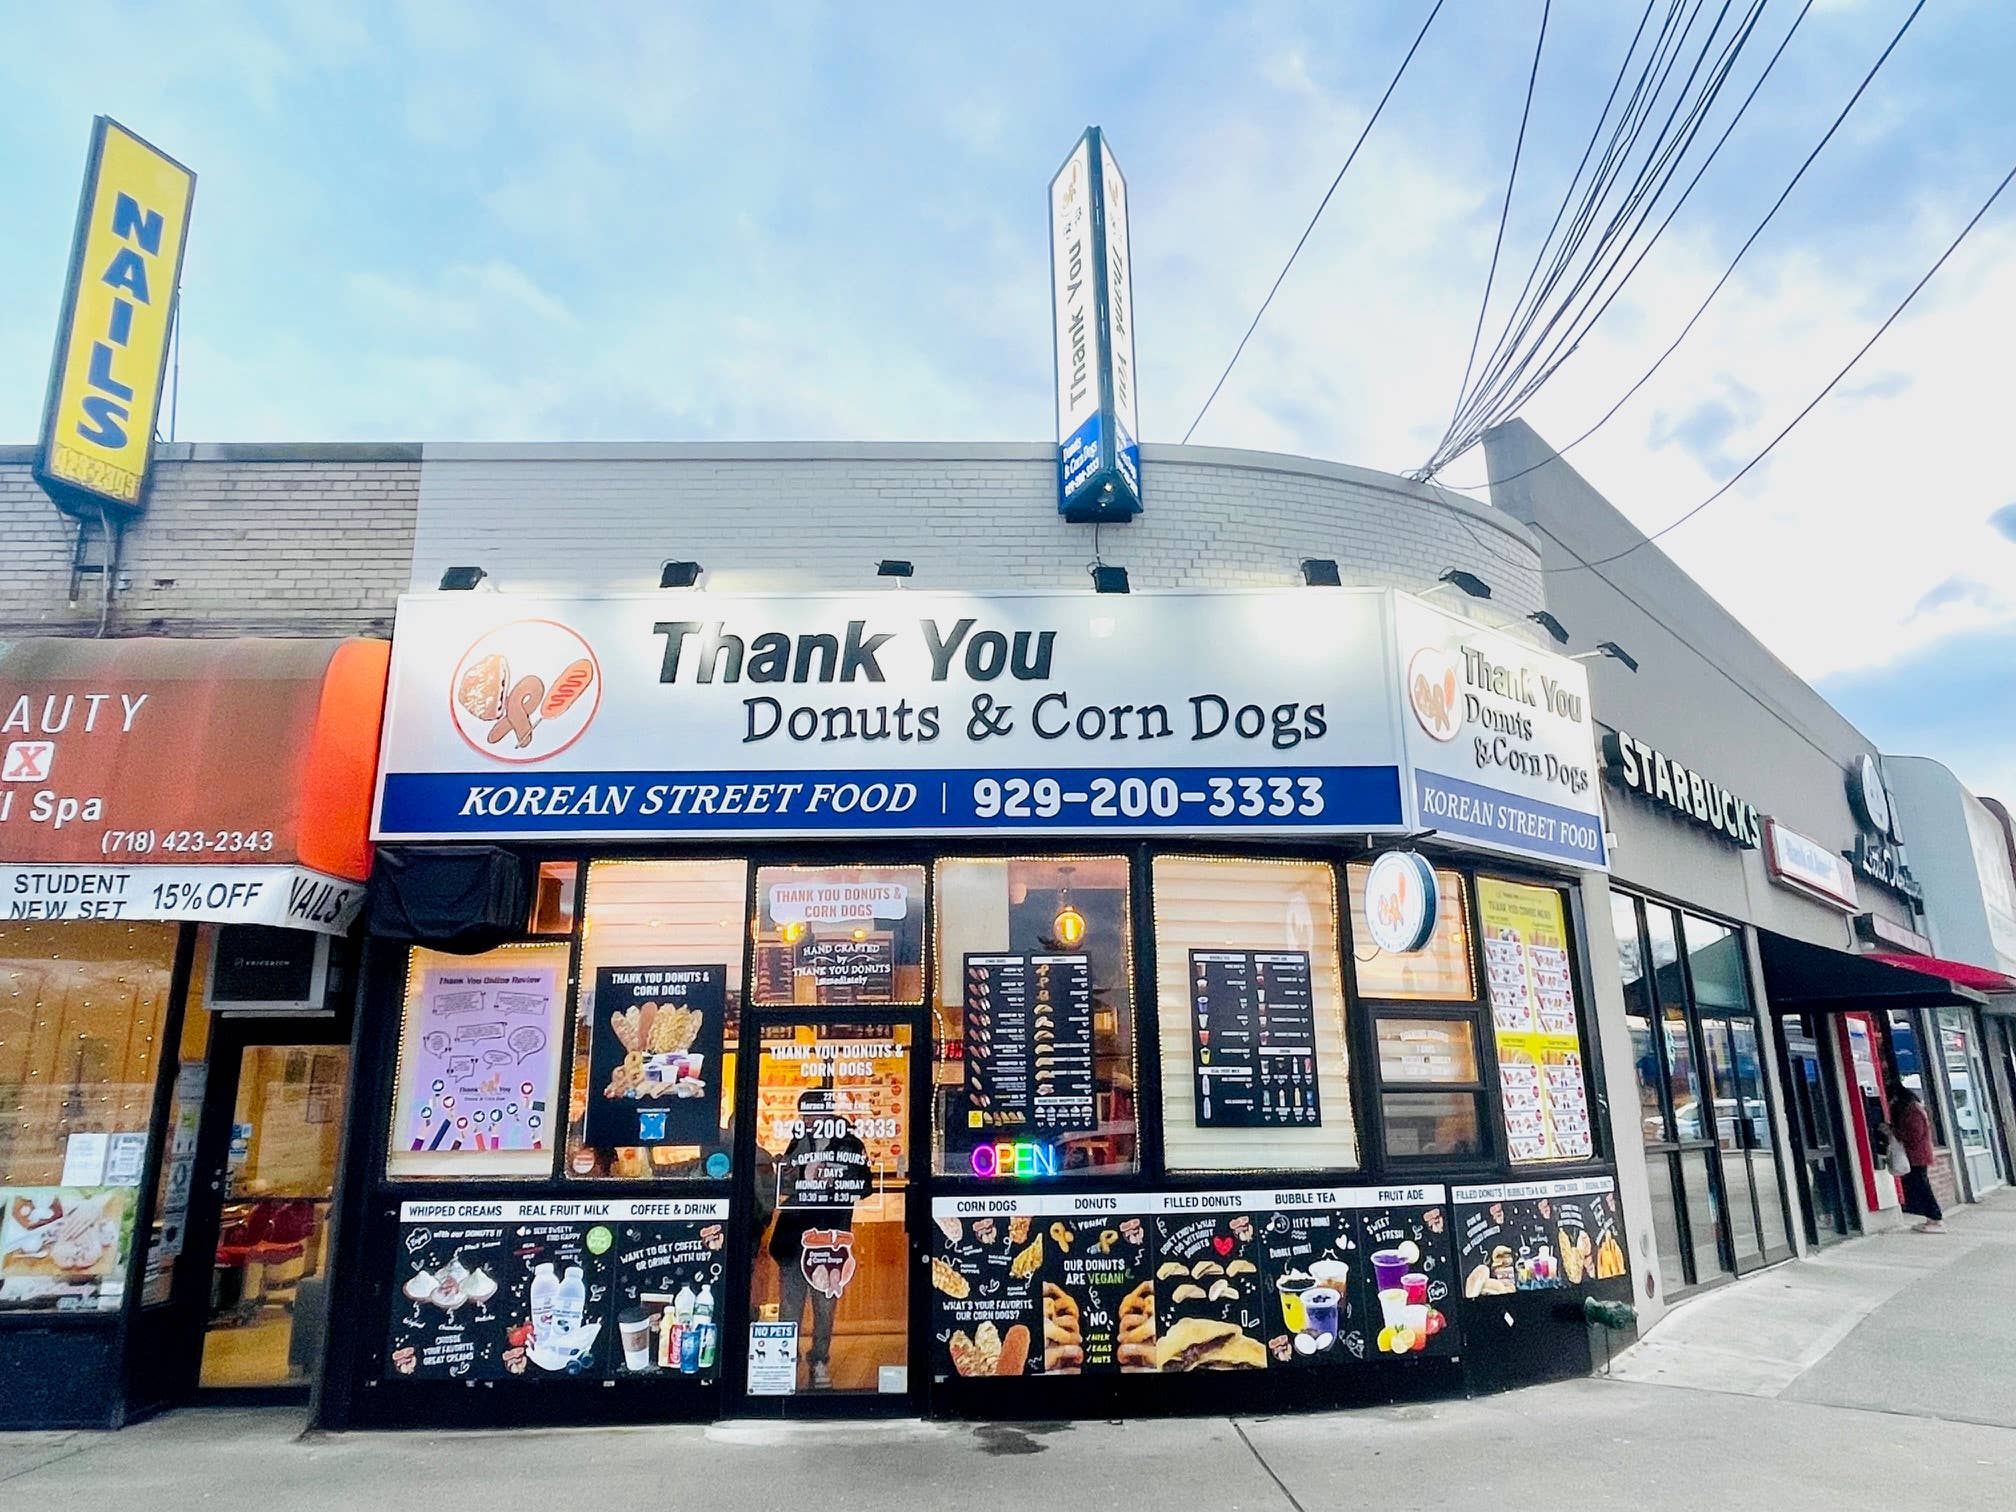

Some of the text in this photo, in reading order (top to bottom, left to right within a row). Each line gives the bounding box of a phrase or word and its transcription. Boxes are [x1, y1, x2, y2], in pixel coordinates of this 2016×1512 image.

[1067, 238, 1083, 304] You
[76, 191, 163, 448] NAILS
[1069, 305, 1087, 411] Thank
[653, 618, 1058, 685] Thank You
[1461, 645, 1583, 723] Thank You
[742, 691, 1328, 750] Donuts & Corn Dogs
[1465, 693, 1533, 741] Donuts
[1473, 735, 1589, 794] & Corn Dogs
[973, 776, 1325, 818] 929-200-3333
[1618, 730, 1761, 850] STARBUCKS
[458, 782, 918, 817] KOREAN STREET FOOD
[29, 788, 103, 830] Spa
[1422, 786, 1598, 851] KOREAN STREET FOOD
[101, 830, 274, 854] (718) 423-2343
[14, 873, 130, 894] STUDENT
[152, 882, 263, 911] 15% OFF
[775, 887, 901, 903] THANK YOU DONUTS &
[9, 900, 128, 920] NEW SET
[804, 904, 873, 918] CORN DOGS
[803, 944, 880, 956] HAND CRAFTED
[611, 971, 710, 984] THANK YOU DONUTS &
[793, 964, 891, 977] THANK YOU DONUTS
[633, 985, 686, 996] CORN DOGS
[770, 1044, 904, 1060] THANK YOU DONUTS &
[800, 1062, 873, 1077] CORN DOGS
[797, 1150, 867, 1166] OPENING HOURS
[971, 1143, 1057, 1177] OPEN
[824, 1168, 844, 1178] DAYS
[795, 1180, 828, 1190] MONDAY
[834, 1180, 866, 1190] SUNDAY
[1164, 1195, 1242, 1208] FILLED DONUTS
[1275, 1192, 1336, 1205] BUBBLE TEA
[1378, 1189, 1424, 1201] FRUIT ADE
[409, 1205, 502, 1217] WHIPPED CREAMS
[519, 1204, 610, 1216] REAL FRUIT MILK
[630, 1203, 717, 1215] COFFEE & DRINK
[957, 1200, 1017, 1212] CORN DOGS
[1074, 1197, 1117, 1210] DONUTS
[620, 1240, 703, 1265] WANT TO GET COFFEE
[672, 1252, 695, 1264] WITH
[1063, 1259, 1125, 1272] OUR DONUTS
[1065, 1272, 1124, 1286] ARE VEGAN!
[974, 1300, 995, 1310] YOUR
[996, 1299, 1033, 1310] FAVORITE
[955, 1310, 1020, 1321] OUR CORN DOGS?
[1090, 1310, 1107, 1327] NO
[754, 1326, 793, 1337] NO PETS
